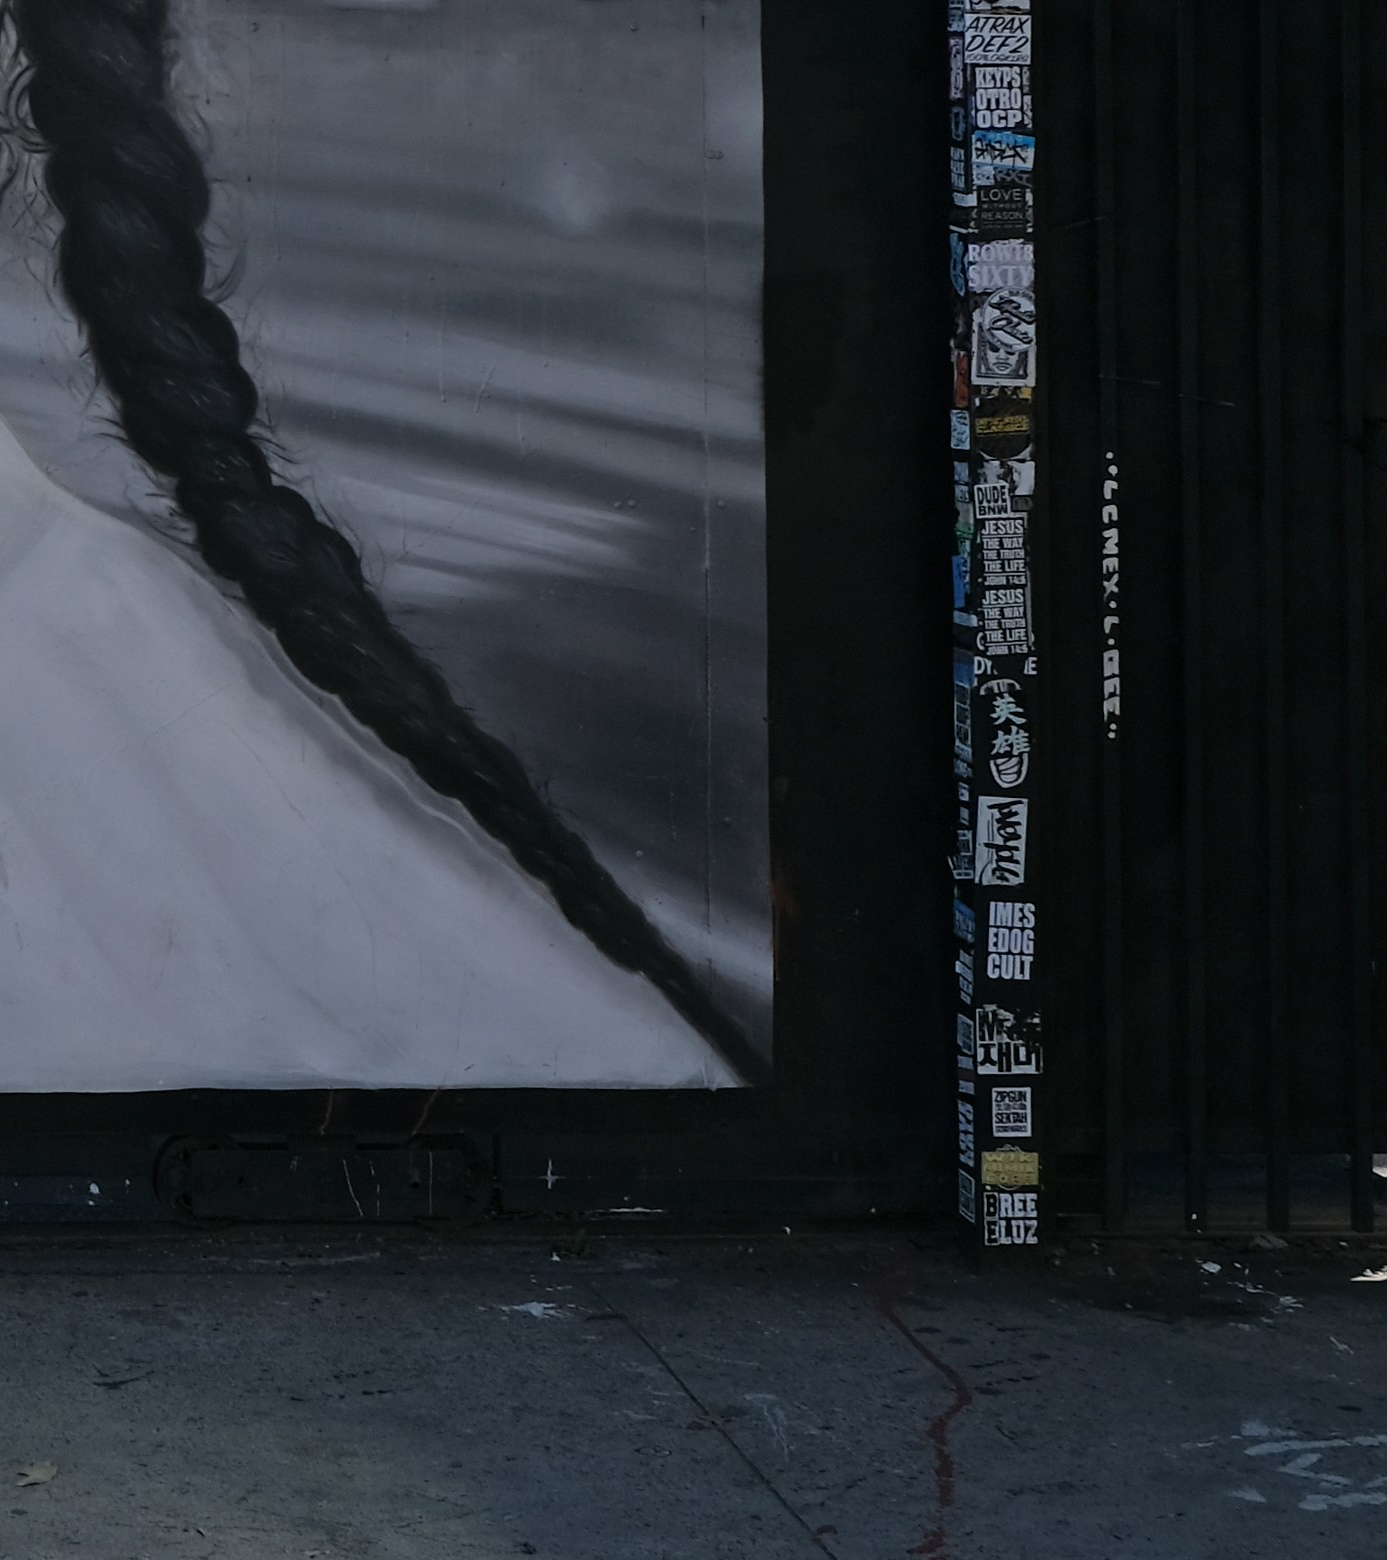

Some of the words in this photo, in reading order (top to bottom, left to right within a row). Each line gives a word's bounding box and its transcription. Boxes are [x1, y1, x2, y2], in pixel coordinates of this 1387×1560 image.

[965, 16, 1030, 34] ATRAX
[975, 88, 1022, 110] OTRO
[976, 109, 1023, 129] OCP
[980, 188, 1023, 201] LOVE
[981, 211, 1024, 220] REASON
[977, 485, 1007, 504] DUDE
[981, 520, 1024, 534] JESUS
[983, 538, 1001, 549] THE
[1003, 537, 1024, 548] WAY
[983, 550, 999, 560] THE
[1000, 549, 1025, 559] TRUTH
[984, 561, 1003, 572] THE
[1004, 559, 1026, 571] LIFE
[982, 589, 1024, 604] JESUS
[984, 608, 1002, 619] THE
[1003, 607, 1025, 617] WAY
[984, 621, 999, 630] THE
[1001, 618, 1026, 628] TRUTH
[985, 630, 1004, 641] THE
[1006, 629, 1027, 641] LIFE
[989, 692, 1032, 756] 英雄
[988, 901, 1036, 928] IMES
[987, 928, 1036, 954] EDOG
[987, 953, 1034, 980] CULT
